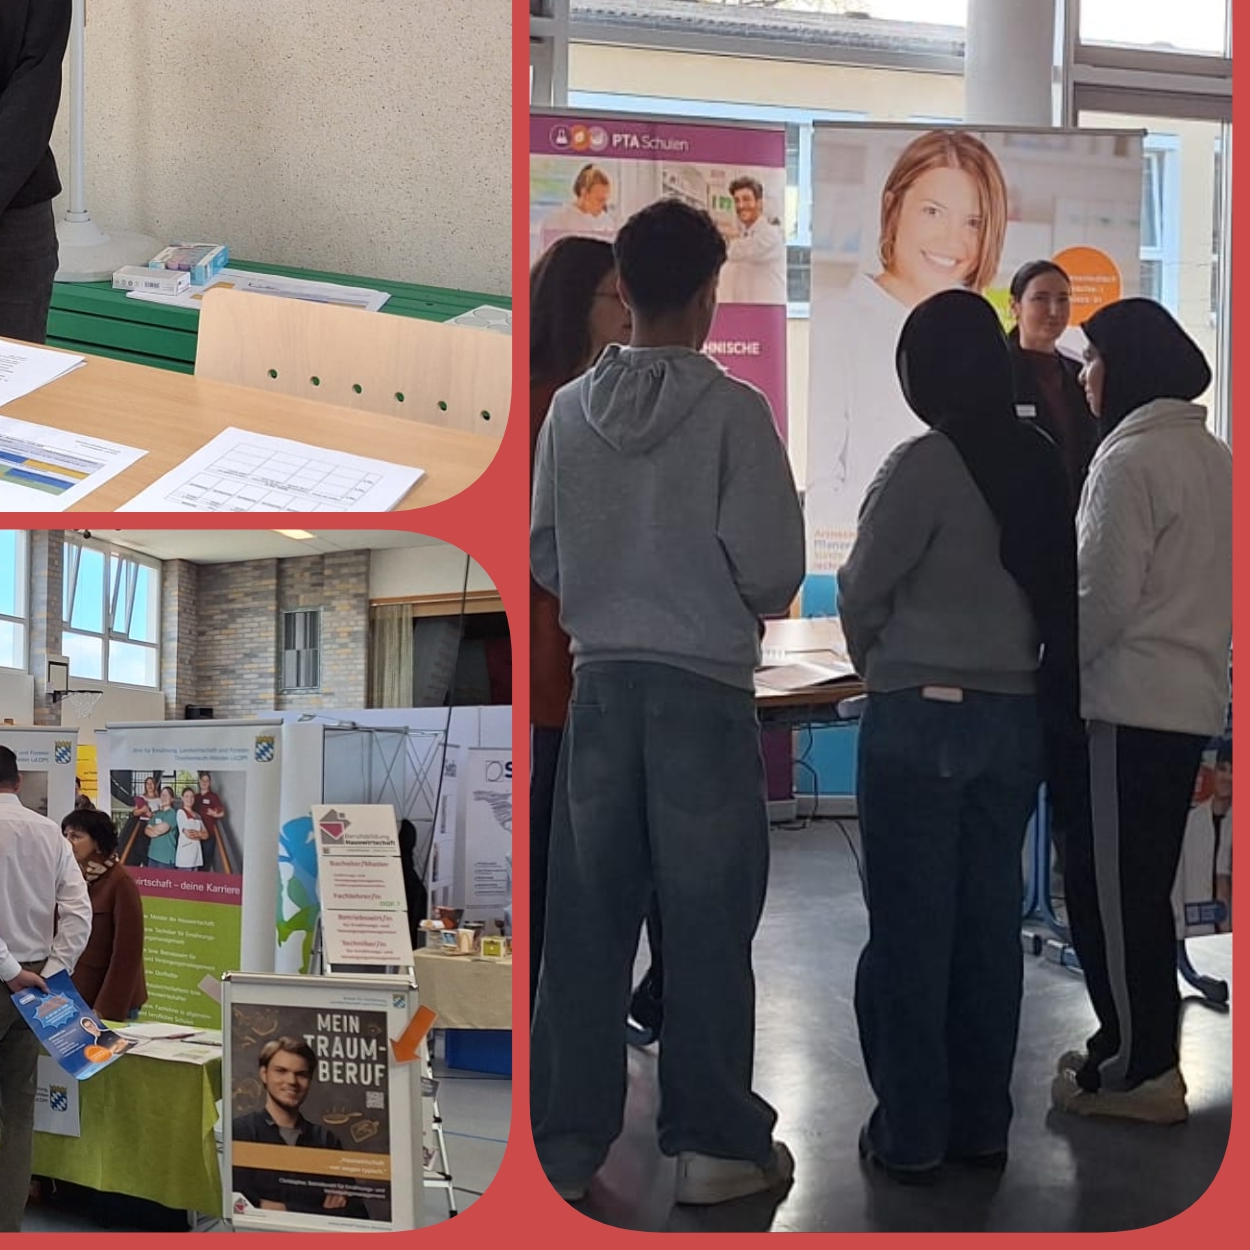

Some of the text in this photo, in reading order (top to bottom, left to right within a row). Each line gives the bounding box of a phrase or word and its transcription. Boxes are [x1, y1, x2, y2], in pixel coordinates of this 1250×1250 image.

[612, 134, 690, 152] PTA Schulen
[180, 882, 204, 891] deine
[206, 883, 241, 895] Karriere
[317, 1012, 360, 1034] MEIN
[304, 1034, 387, 1062] TRAUM-
[318, 1060, 386, 1086] BERUF
